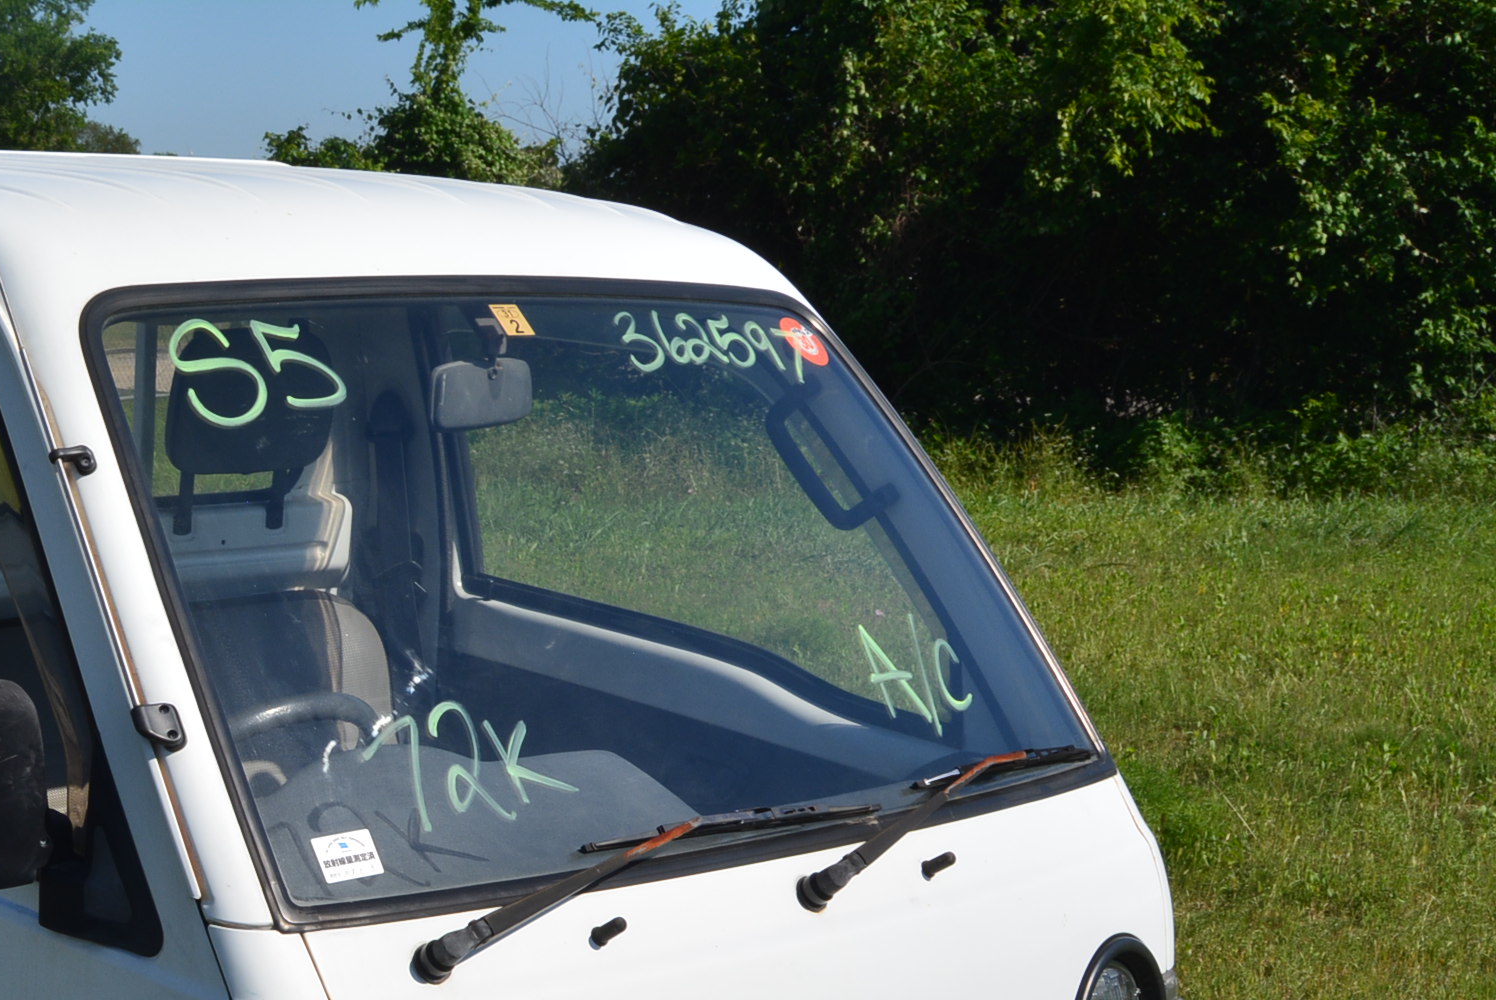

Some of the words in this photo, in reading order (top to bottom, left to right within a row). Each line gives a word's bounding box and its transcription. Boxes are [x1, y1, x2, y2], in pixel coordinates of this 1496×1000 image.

[510, 319, 525, 334] 2
[614, 310, 805, 384] 362597
[858, 613, 973, 737] A/C
[361, 701, 579, 832] 72K
